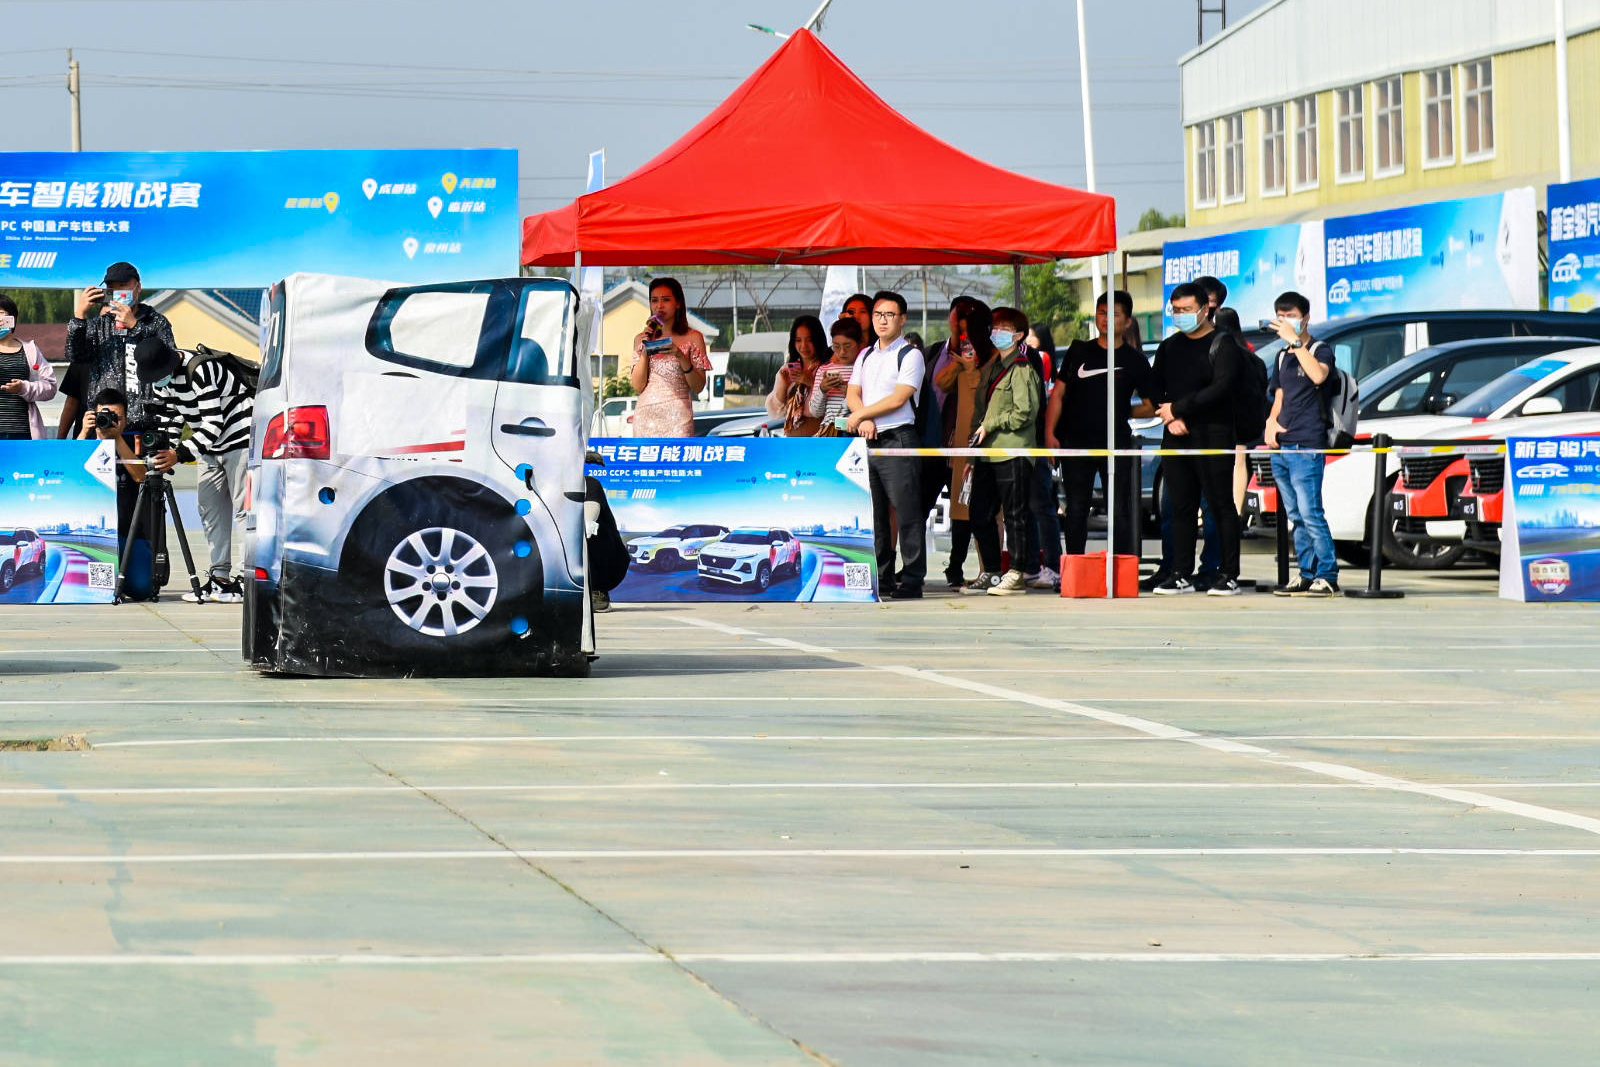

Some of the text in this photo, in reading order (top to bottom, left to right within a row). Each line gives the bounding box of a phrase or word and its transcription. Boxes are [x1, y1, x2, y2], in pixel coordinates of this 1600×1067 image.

[21, 220, 131, 233] 中国量产车性能大赛
[1550, 202, 1600, 242] 新宝骏汽
[588, 469, 608, 477] 2020
[609, 469, 631, 477] CCPC
